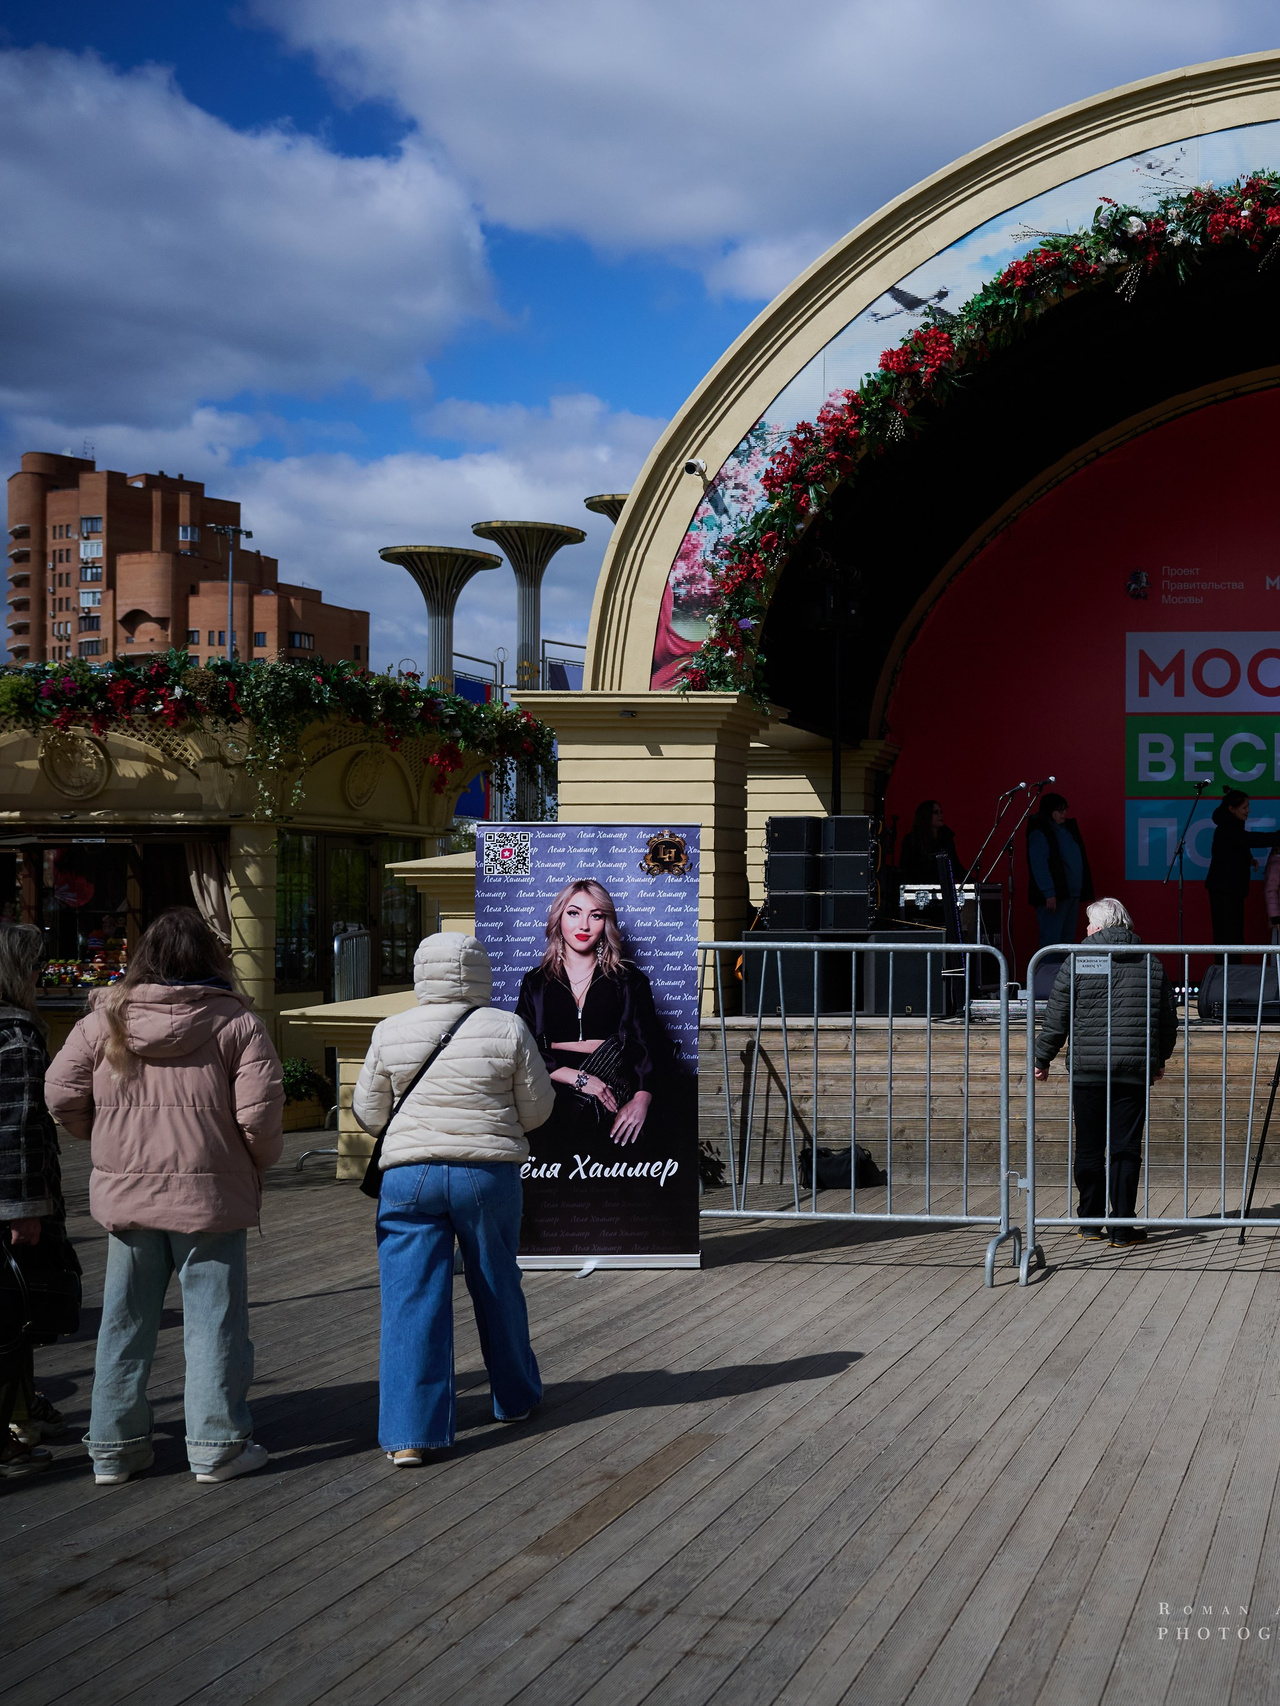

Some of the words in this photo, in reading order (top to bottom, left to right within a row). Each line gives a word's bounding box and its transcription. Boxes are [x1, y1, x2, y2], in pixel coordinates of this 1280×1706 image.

[1162, 566, 1200, 577] Проект
[1162, 580, 1244, 591] Правительства
[1162, 595, 1203, 604] Москвы
[535, 831, 566, 840] Хаммер
[577, 831, 595, 839] Леля
[597, 831, 627, 840] Хаммер
[567, 846, 598, 855] Хаммер
[535, 861, 566, 870] Хаммер
[596, 861, 627, 870] Хаммер
[483, 875, 501, 883] Леля
[504, 875, 535, 885] Хаммер
[546, 875, 564, 883] Леля
[606, 875, 623, 883] Леля
[625, 875, 656, 885] Хаммер
[665, 875, 682, 883] Леля
[475, 890, 506, 899] Хаммер
[516, 890, 534, 898] Леля
[536, 890, 559, 898] Хамм
[637, 890, 655, 898] Леля
[657, 890, 687, 899] Хаммер
[504, 905, 535, 914] Хаммер
[625, 905, 655, 914] Хаммер
[653, 920, 683, 929] Хаммер
[504, 935, 536, 944] Хаммер
[666, 934, 683, 942] Леля
[653, 949, 684, 958] Хаммер
[655, 979, 685, 988] Хаммер
[520, 1155, 562, 1179] ёля
[568, 1154, 679, 1187] Хаммер
